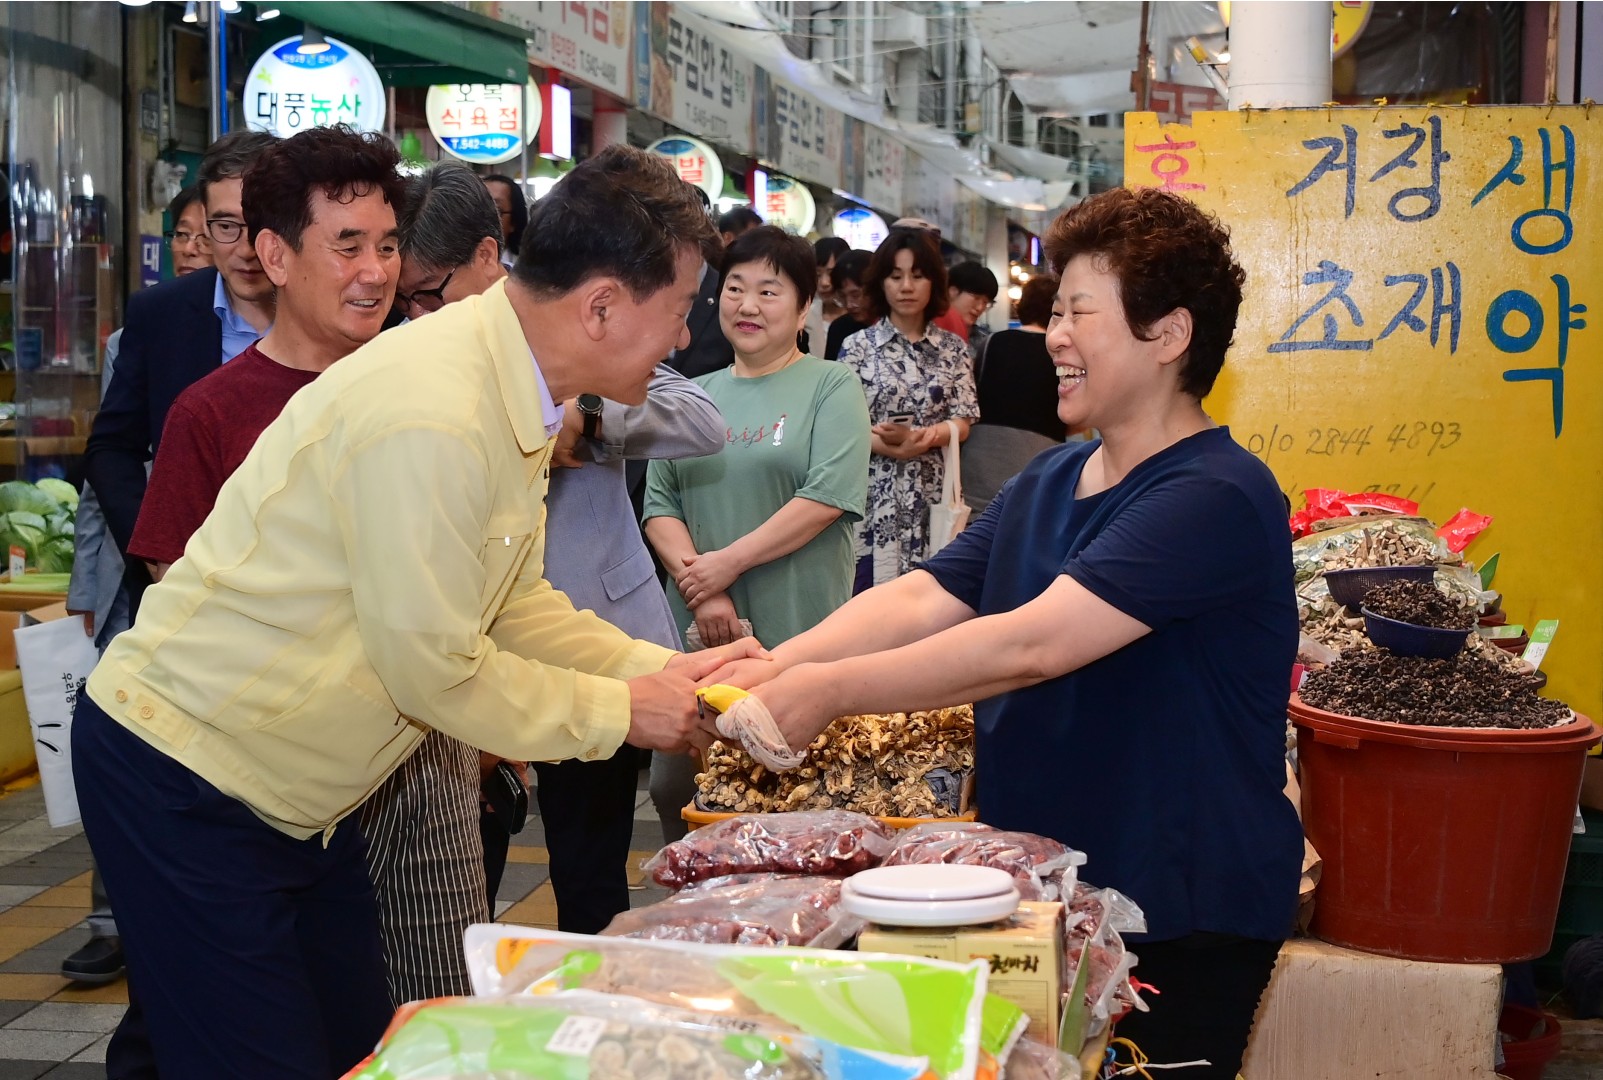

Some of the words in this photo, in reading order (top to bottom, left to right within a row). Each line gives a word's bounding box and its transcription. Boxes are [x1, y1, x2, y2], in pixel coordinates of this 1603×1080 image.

[257, 92, 363, 128] 대풍농산
[441, 107, 517, 131] 식육점
[456, 84, 502, 103] 오복
[1286, 115, 1451, 223] 거창
[1266, 260, 1462, 356] 초재
[1471, 124, 1588, 439] 생약
